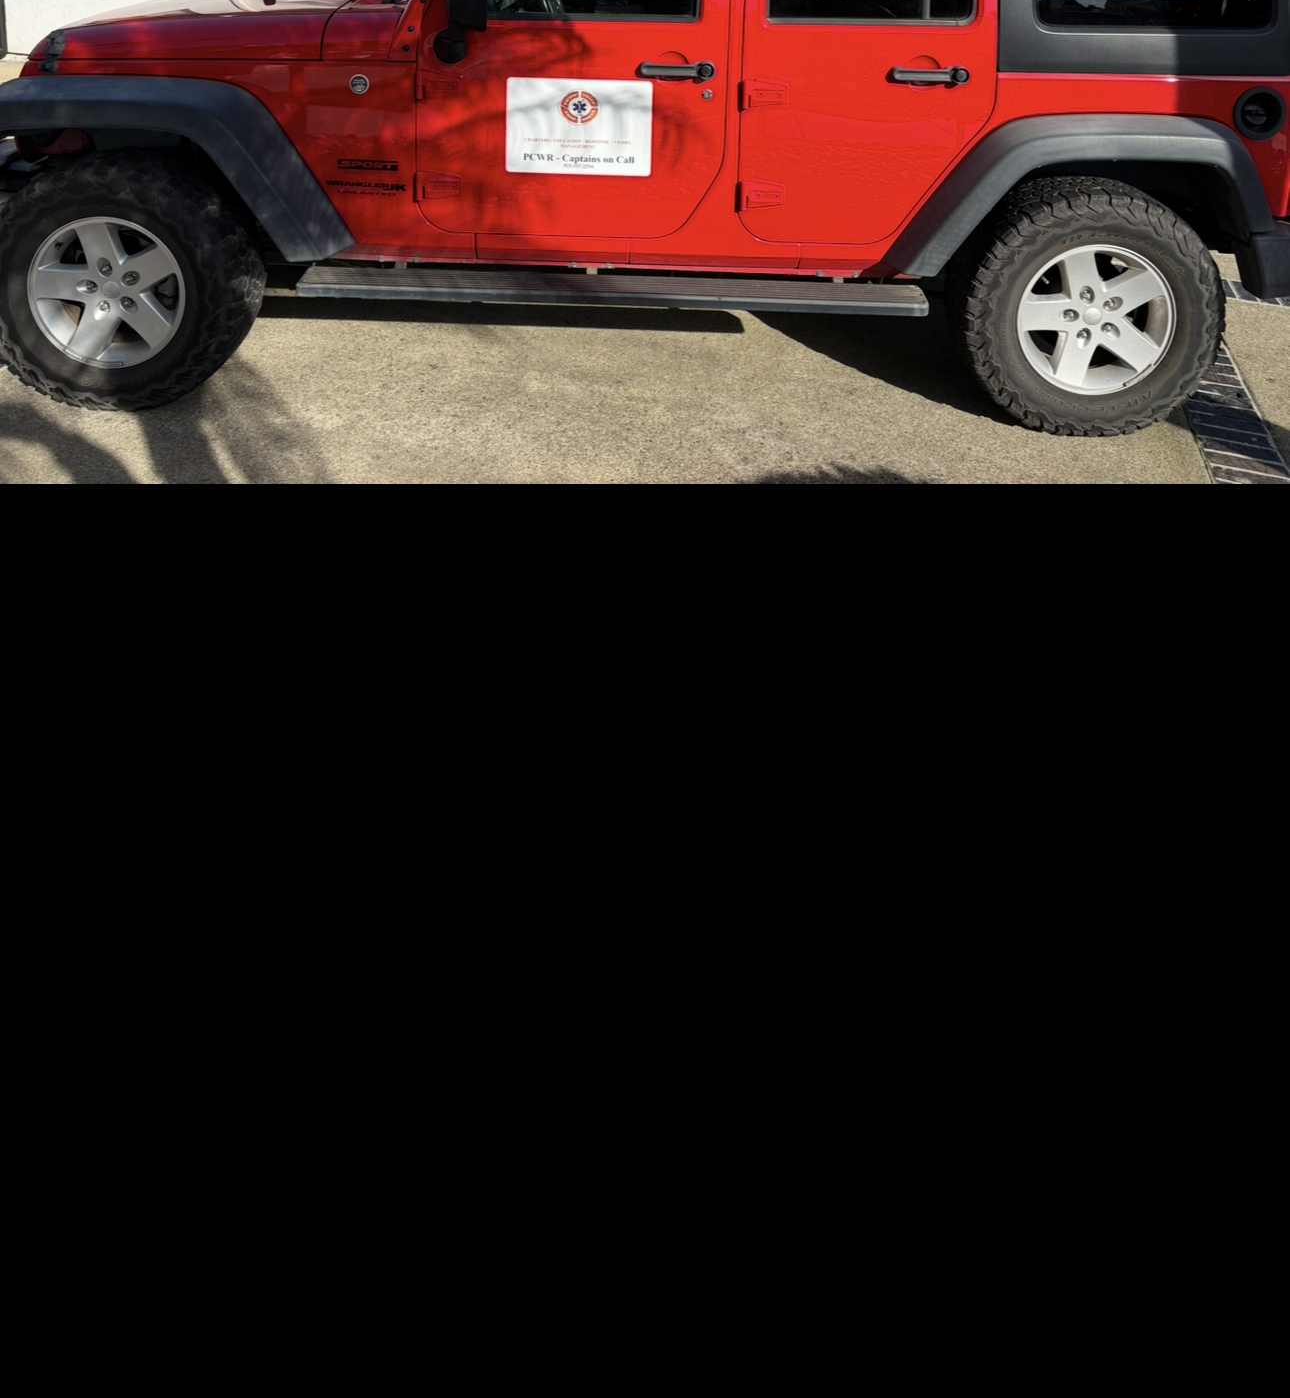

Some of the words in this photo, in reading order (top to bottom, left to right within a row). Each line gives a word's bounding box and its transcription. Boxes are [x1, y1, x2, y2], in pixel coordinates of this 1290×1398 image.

[523, 153, 554, 162] PCWR
[562, 154, 601, 164] Captains
[616, 156, 635, 164] Call
[340, 160, 394, 169] SPORT
[325, 179, 388, 189] WRANGLER
